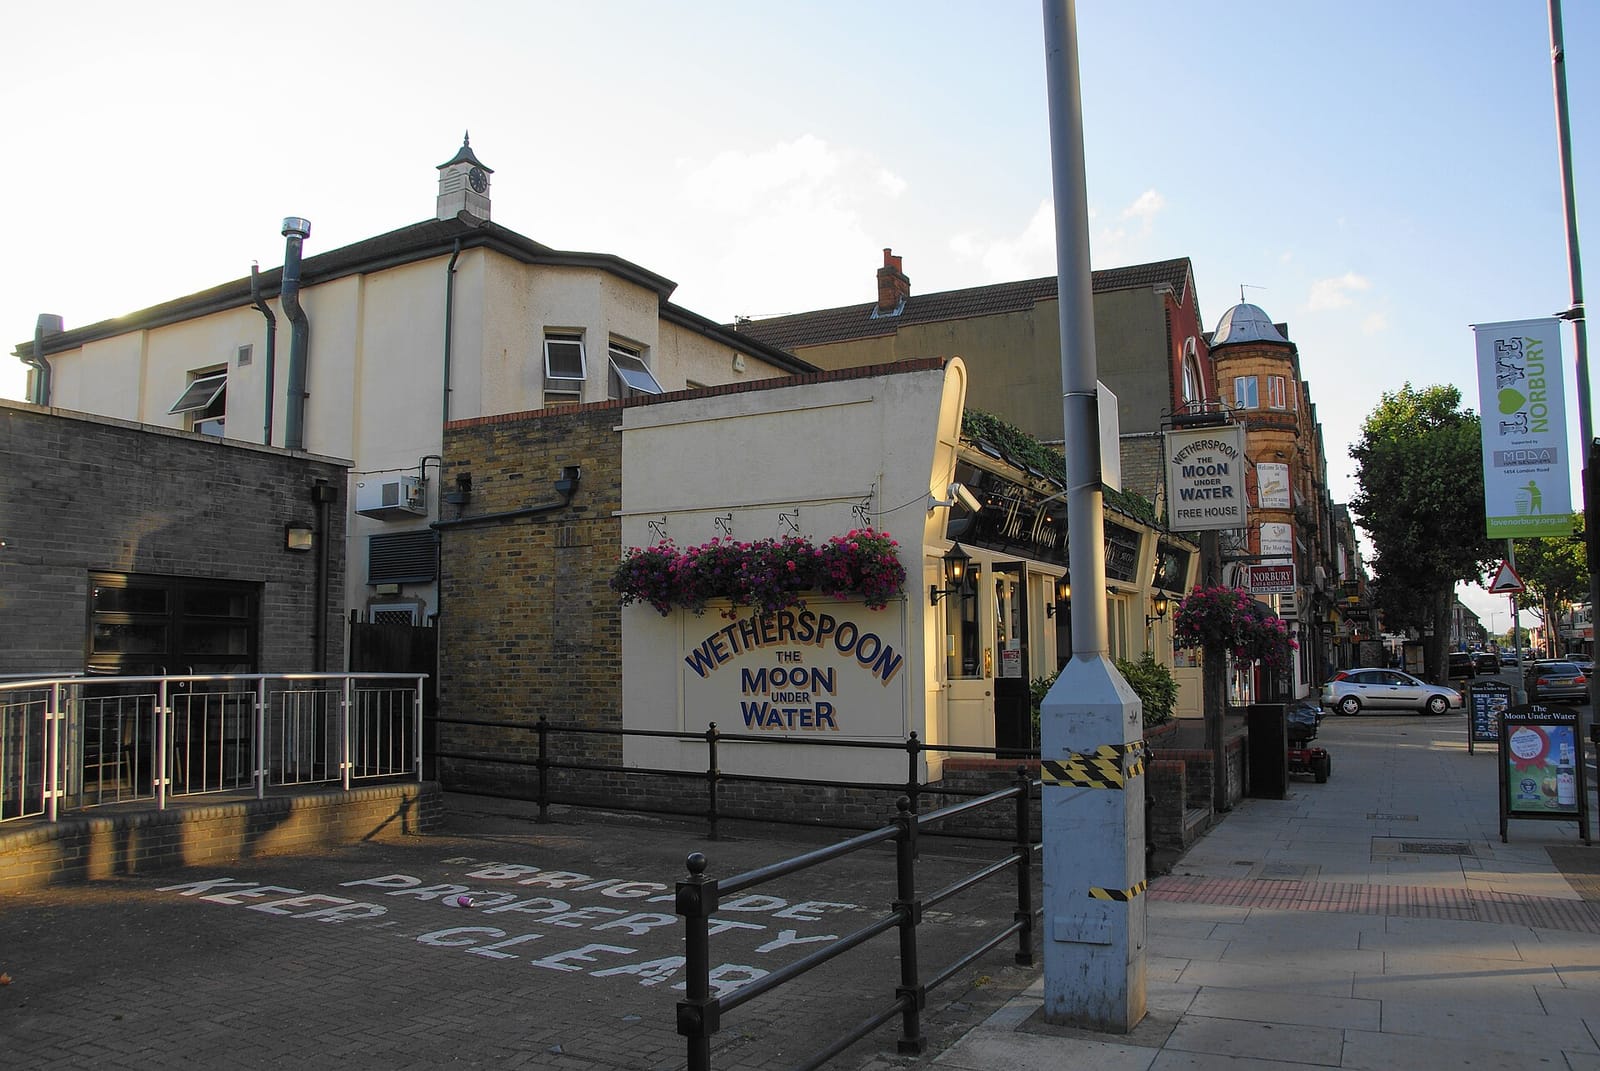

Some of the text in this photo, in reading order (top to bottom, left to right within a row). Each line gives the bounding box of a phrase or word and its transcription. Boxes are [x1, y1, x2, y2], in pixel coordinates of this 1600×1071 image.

[1525, 337, 1549, 432] NORBURY
[1172, 439, 1239, 465] WETHERSPOON
[1503, 450, 1550, 461] MODA
[1182, 463, 1229, 478] MOON
[1194, 478, 1221, 486] UNDER
[1180, 485, 1234, 501] WATER
[997, 495, 1024, 540] The
[1177, 506, 1238, 518] FREE HOUSE
[1491, 516, 1568, 527] lovenorbury.org.uk
[1253, 572, 1290, 581] NORBURY
[684, 611, 903, 687] WETHERSPOON
[776, 650, 801, 663] THE
[741, 667, 836, 696] MOON
[771, 692, 810, 703] UNDER
[740, 701, 838, 730] WATER
[155, 877, 388, 923] KEEP
[465, 864, 857, 921] BRIGDE
